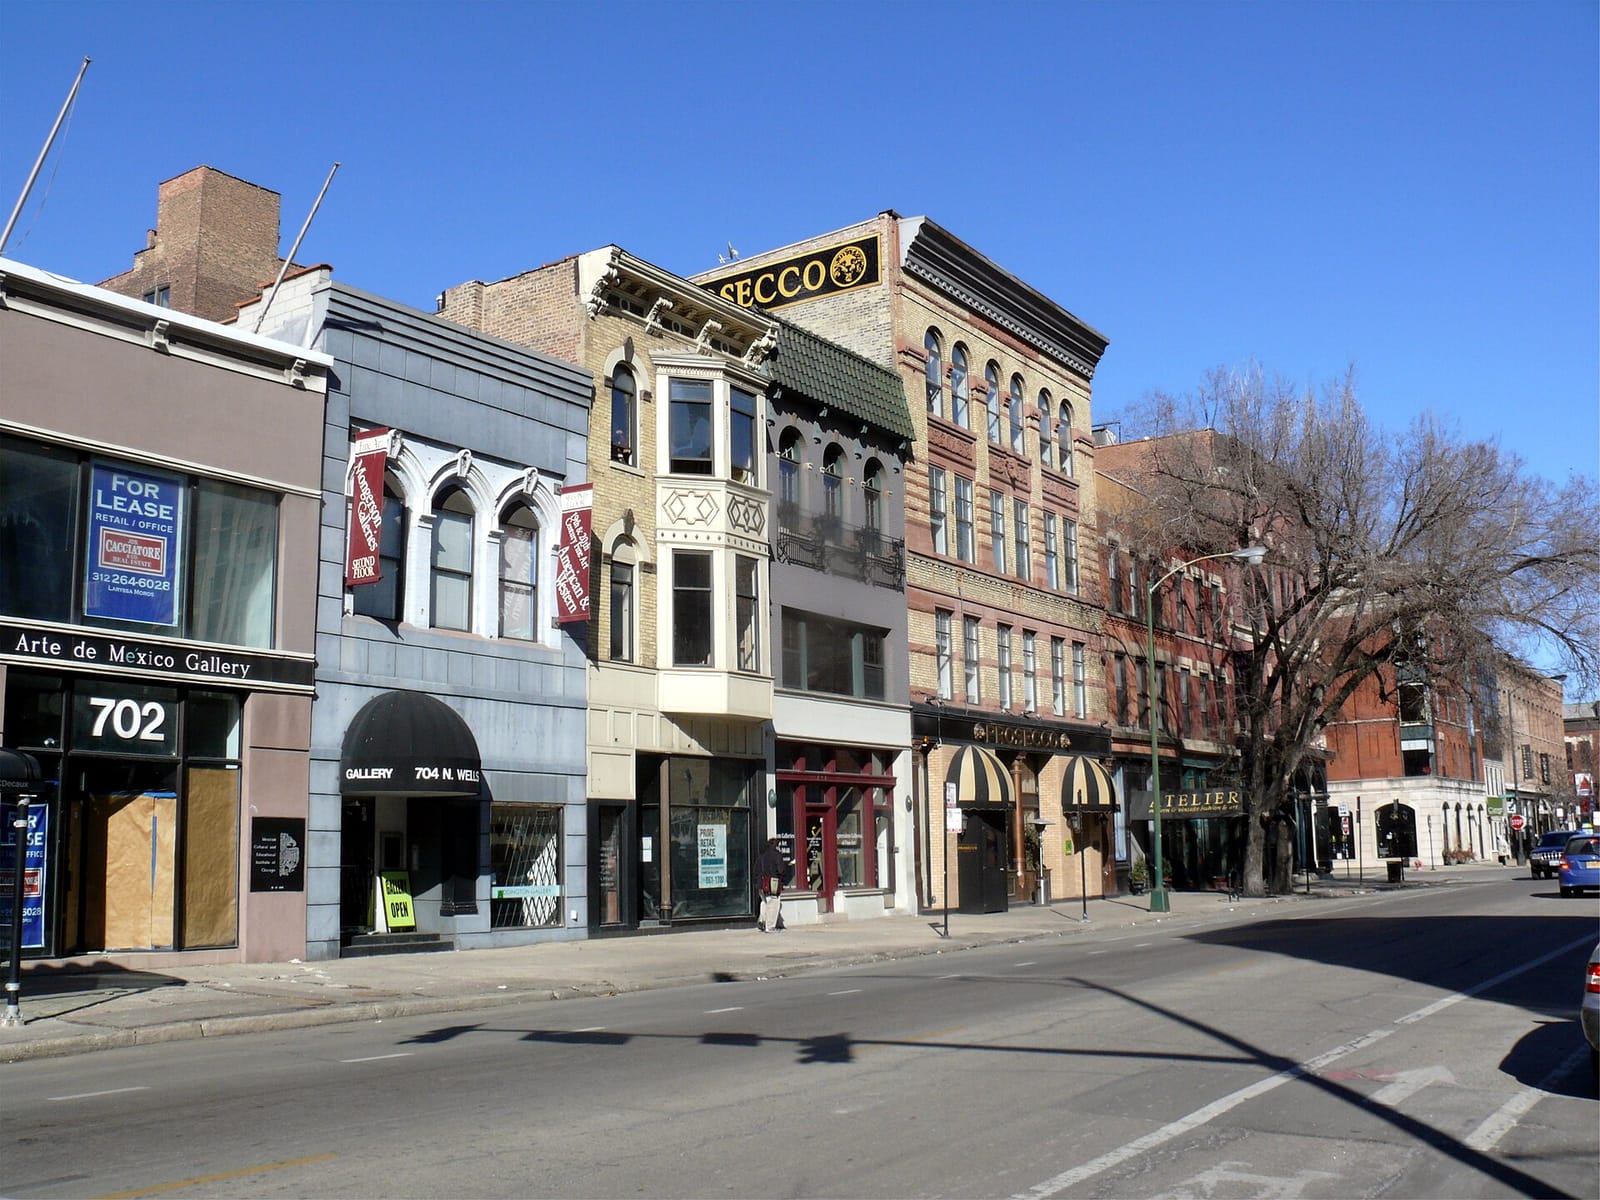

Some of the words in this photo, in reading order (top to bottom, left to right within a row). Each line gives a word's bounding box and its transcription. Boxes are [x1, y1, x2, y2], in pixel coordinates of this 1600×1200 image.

[707, 260, 827, 308] SECCO
[112, 472, 160, 499] FOR
[353, 458, 382, 529] Mongerson
[96, 489, 174, 520] LEASE
[95, 512, 130, 526] RETAIL
[138, 520, 174, 533] OFFICE
[358, 501, 378, 552] Galleries
[105, 539, 161, 560] CACCIATORE
[574, 541, 584, 559] Fine
[579, 556, 590, 569] Art
[352, 556, 376, 570] SECOND
[353, 566, 376, 579] FLOOR
[92, 572, 110, 583] 312
[111, 573, 171, 591] 264-6028
[558, 545, 584, 599] American
[579, 595, 590, 611] &
[556, 570, 577, 614] Western
[15, 633, 61, 655] Arte
[74, 641, 97, 659] de
[109, 644, 175, 668] México
[185, 653, 251, 679] Gallery
[89, 697, 165, 741] 702
[985, 723, 1059, 748] PROSECCO
[0, 779, 29, 788] Decaux
[345, 768, 394, 779] GALLERY
[414, 767, 440, 780] 704
[442, 768, 454, 780] N.
[457, 769, 480, 782] WELLS
[8, 811, 37, 829] FR
[1511, 817, 1524, 826] STOP
[700, 848, 716, 857] SPACE
[391, 901, 409, 918] OPEN
